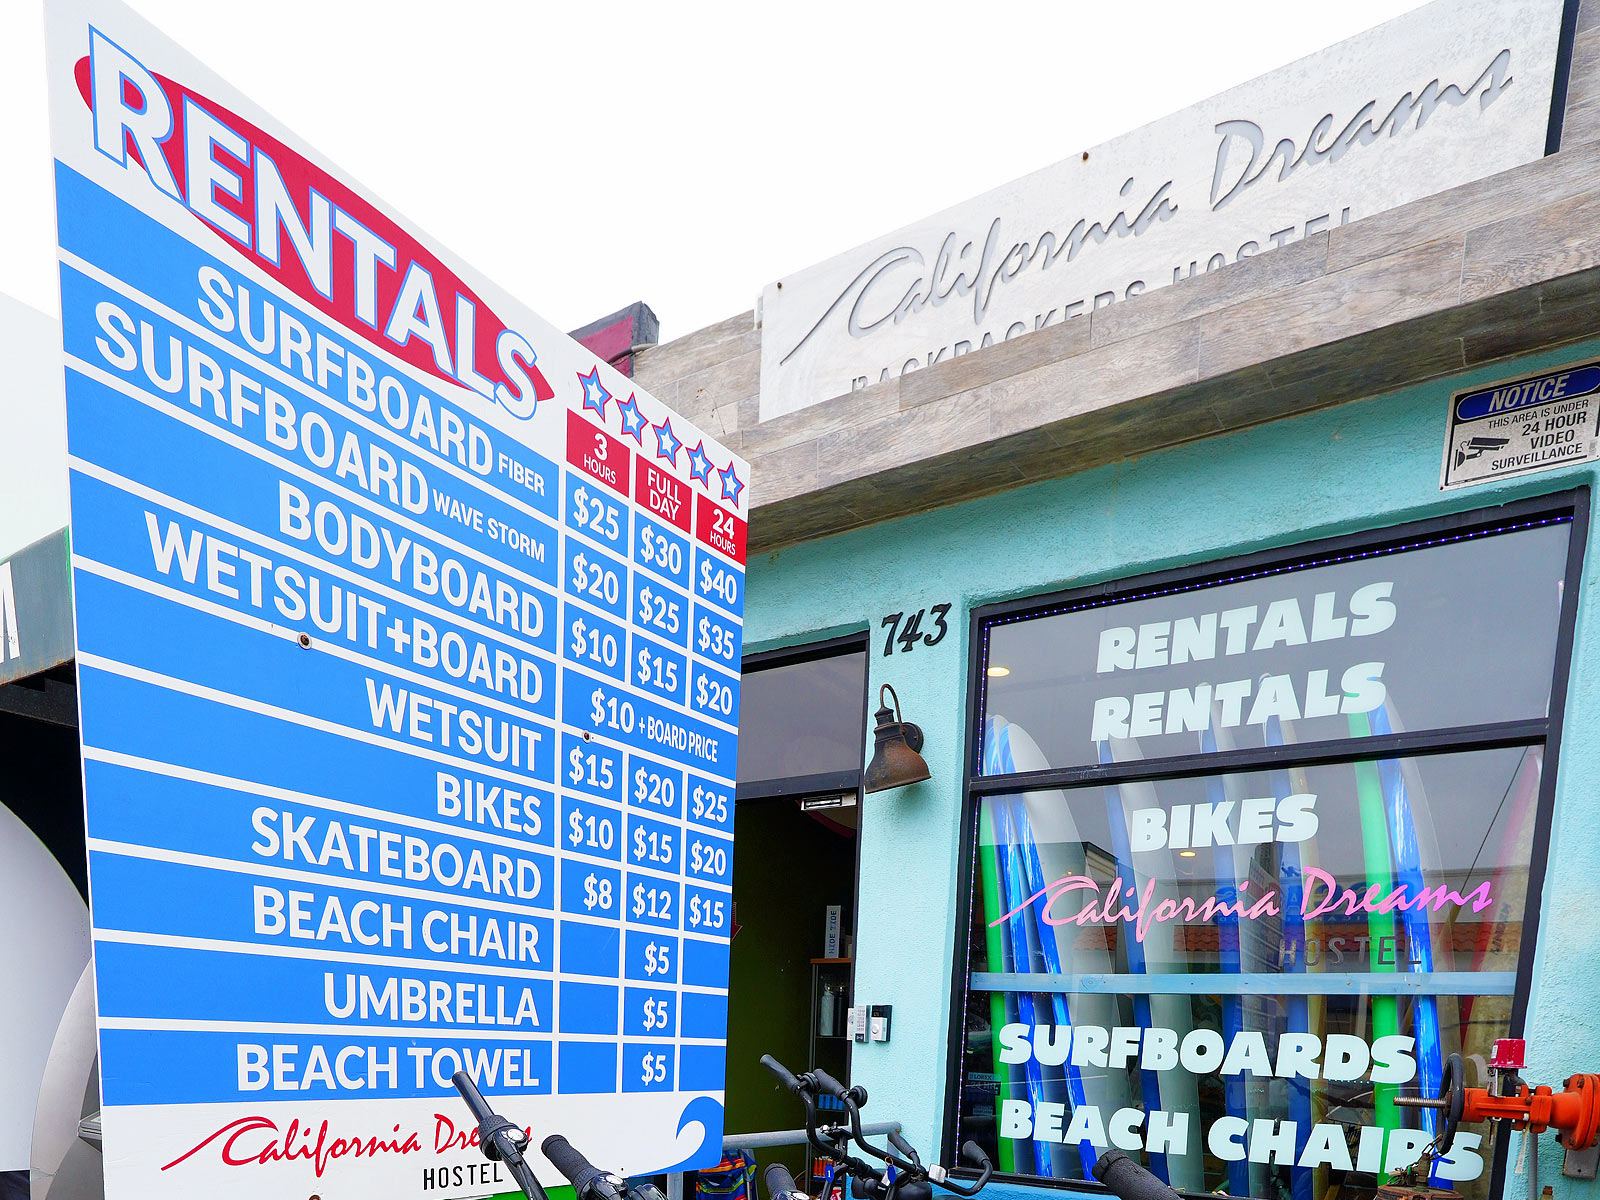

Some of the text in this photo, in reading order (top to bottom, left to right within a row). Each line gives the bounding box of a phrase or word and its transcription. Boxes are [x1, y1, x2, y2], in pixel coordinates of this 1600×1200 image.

[88, 23, 538, 422] RENTALS
[780, 48, 1515, 367] California Dreams
[197, 265, 545, 497] SURFBOARD FIBER
[1488, 374, 1570, 412] NOTICE
[94, 301, 545, 564] SURFBOARD WAVE STORM
[1488, 399, 1589, 429] THIS AREA IS UNDER
[1522, 411, 1587, 436] 24 HOUR
[593, 432, 608, 461] 3
[1491, 442, 1583, 471] SURVEILLANCE
[1530, 429, 1575, 449] VIDEO
[583, 453, 616, 485] HOURS
[647, 467, 682, 506] FULL
[573, 485, 620, 541] $25
[649, 488, 680, 521] DAY
[712, 508, 735, 540] 24
[279, 479, 544, 638] BODYBOARD
[640, 524, 682, 575] $30
[710, 530, 736, 556] HOURS
[572, 552, 619, 605] $20
[699, 558, 738, 605] $40
[638, 585, 680, 634] $25
[881, 602, 952, 657] 743
[1096, 581, 1397, 674] RENTALS
[571, 617, 618, 668] $10
[697, 615, 735, 660] $35
[637, 647, 678, 693] $15
[695, 672, 733, 716] $20
[1090, 661, 1387, 743] RENTALS
[365, 677, 542, 772] WETSUIT
[590, 687, 635, 734] $10
[647, 715, 688, 751] BOARD
[688, 731, 718, 763] PRICE
[568, 745, 614, 790] $15
[634, 766, 675, 808] $20
[436, 771, 542, 836] BIKES
[692, 784, 728, 823] $25
[1131, 793, 1319, 853] BIKES
[568, 807, 614, 851] $10
[633, 824, 673, 864] $15
[251, 806, 542, 900] SKATEBOARD
[690, 839, 727, 876] $20
[583, 872, 613, 911] $8
[632, 882, 672, 921] $12
[689, 893, 724, 929] $15
[989, 875, 1280, 944] California
[1300, 865, 1493, 922] Dreams
[253, 884, 541, 963] BEACH CHAIR
[644, 941, 670, 977] $5
[1277, 935, 1422, 969] HOSTEL
[324, 972, 540, 1027] UMBRELLA
[642, 996, 668, 1032] $5
[236, 1043, 540, 1091] BEACH TOWEL
[641, 1051, 667, 1086] $5
[999, 1022, 1417, 1084] SURFBOARDS
[160, 1113, 533, 1178] California Dres
[1000, 1099, 1484, 1182] BEACH CHAIRS
[423, 1162, 504, 1191] HOSTEL
